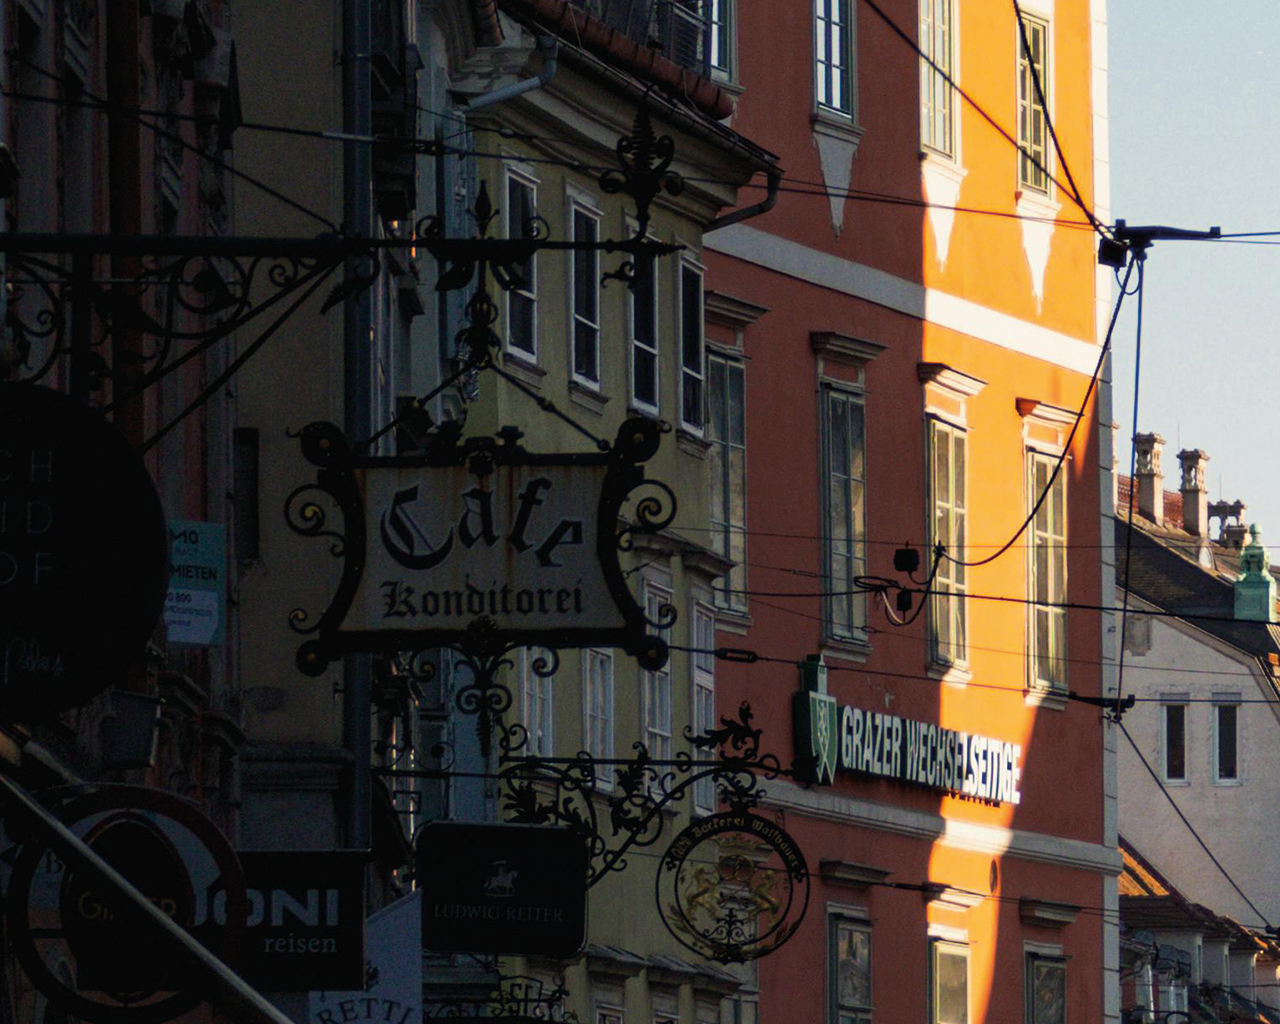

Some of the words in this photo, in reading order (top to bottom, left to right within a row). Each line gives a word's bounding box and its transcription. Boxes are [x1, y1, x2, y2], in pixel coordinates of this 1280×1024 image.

[380, 573, 583, 618] Konditorei
[841, 705, 902, 777] GRAZER
[906, 718, 1021, 804] WECHSELSEITIGE
[434, 904, 500, 919] LUDWIG
[506, 906, 564, 922] REITER
[264, 932, 337, 954] reisen
